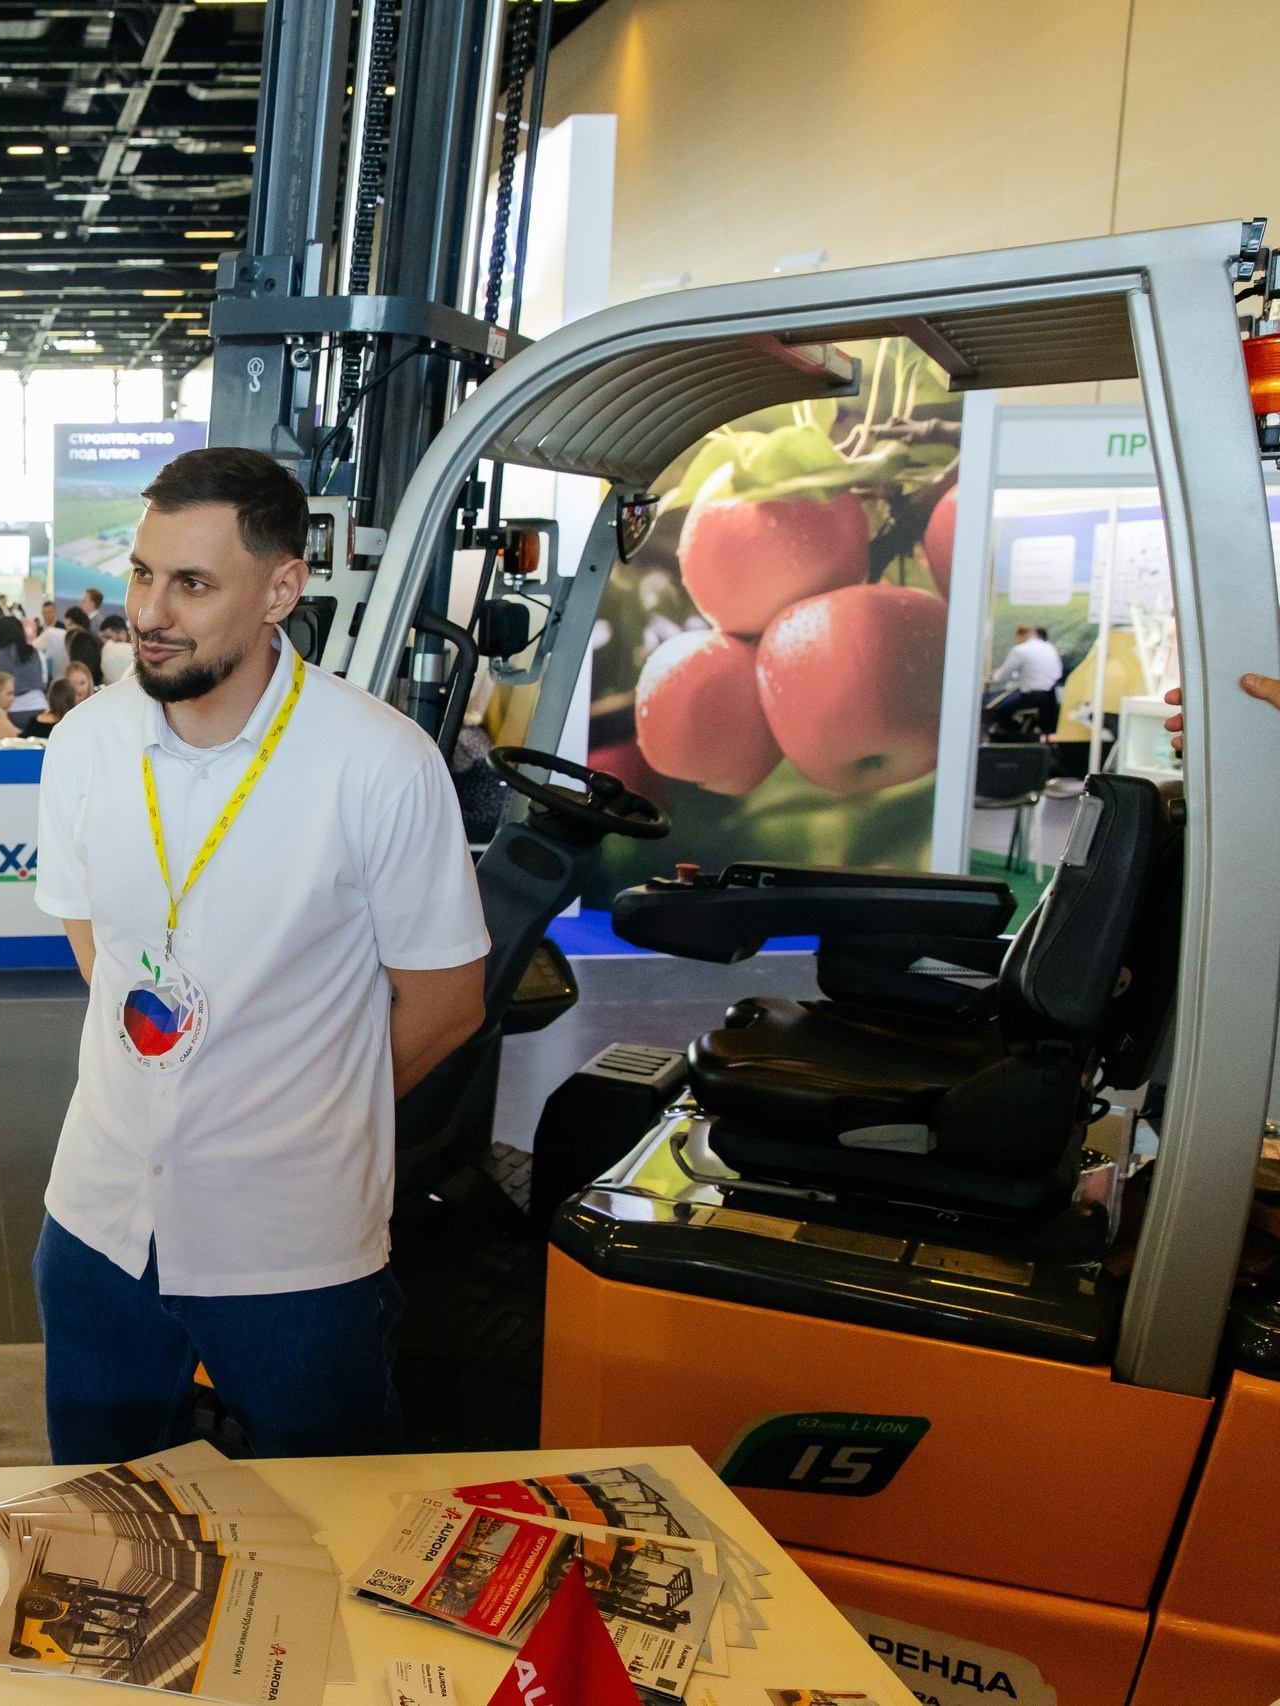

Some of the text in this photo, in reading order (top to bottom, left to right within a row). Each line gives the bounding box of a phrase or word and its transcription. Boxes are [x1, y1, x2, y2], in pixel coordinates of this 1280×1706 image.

[69, 432, 174, 445] СТРОИТЕЛЬСТВО
[1106, 434, 1149, 456] ПР
[69, 448, 97, 461] ПОД
[789, 1445, 883, 1484] 15
[422, 1522, 454, 1562] AURORA
[248, 1571, 262, 1606] Вилочные
[240, 1607, 253, 1646] погрузчики
[234, 1646, 245, 1668] серии
[232, 1668, 242, 1676] N
[268, 1659, 283, 1701] AURORA
